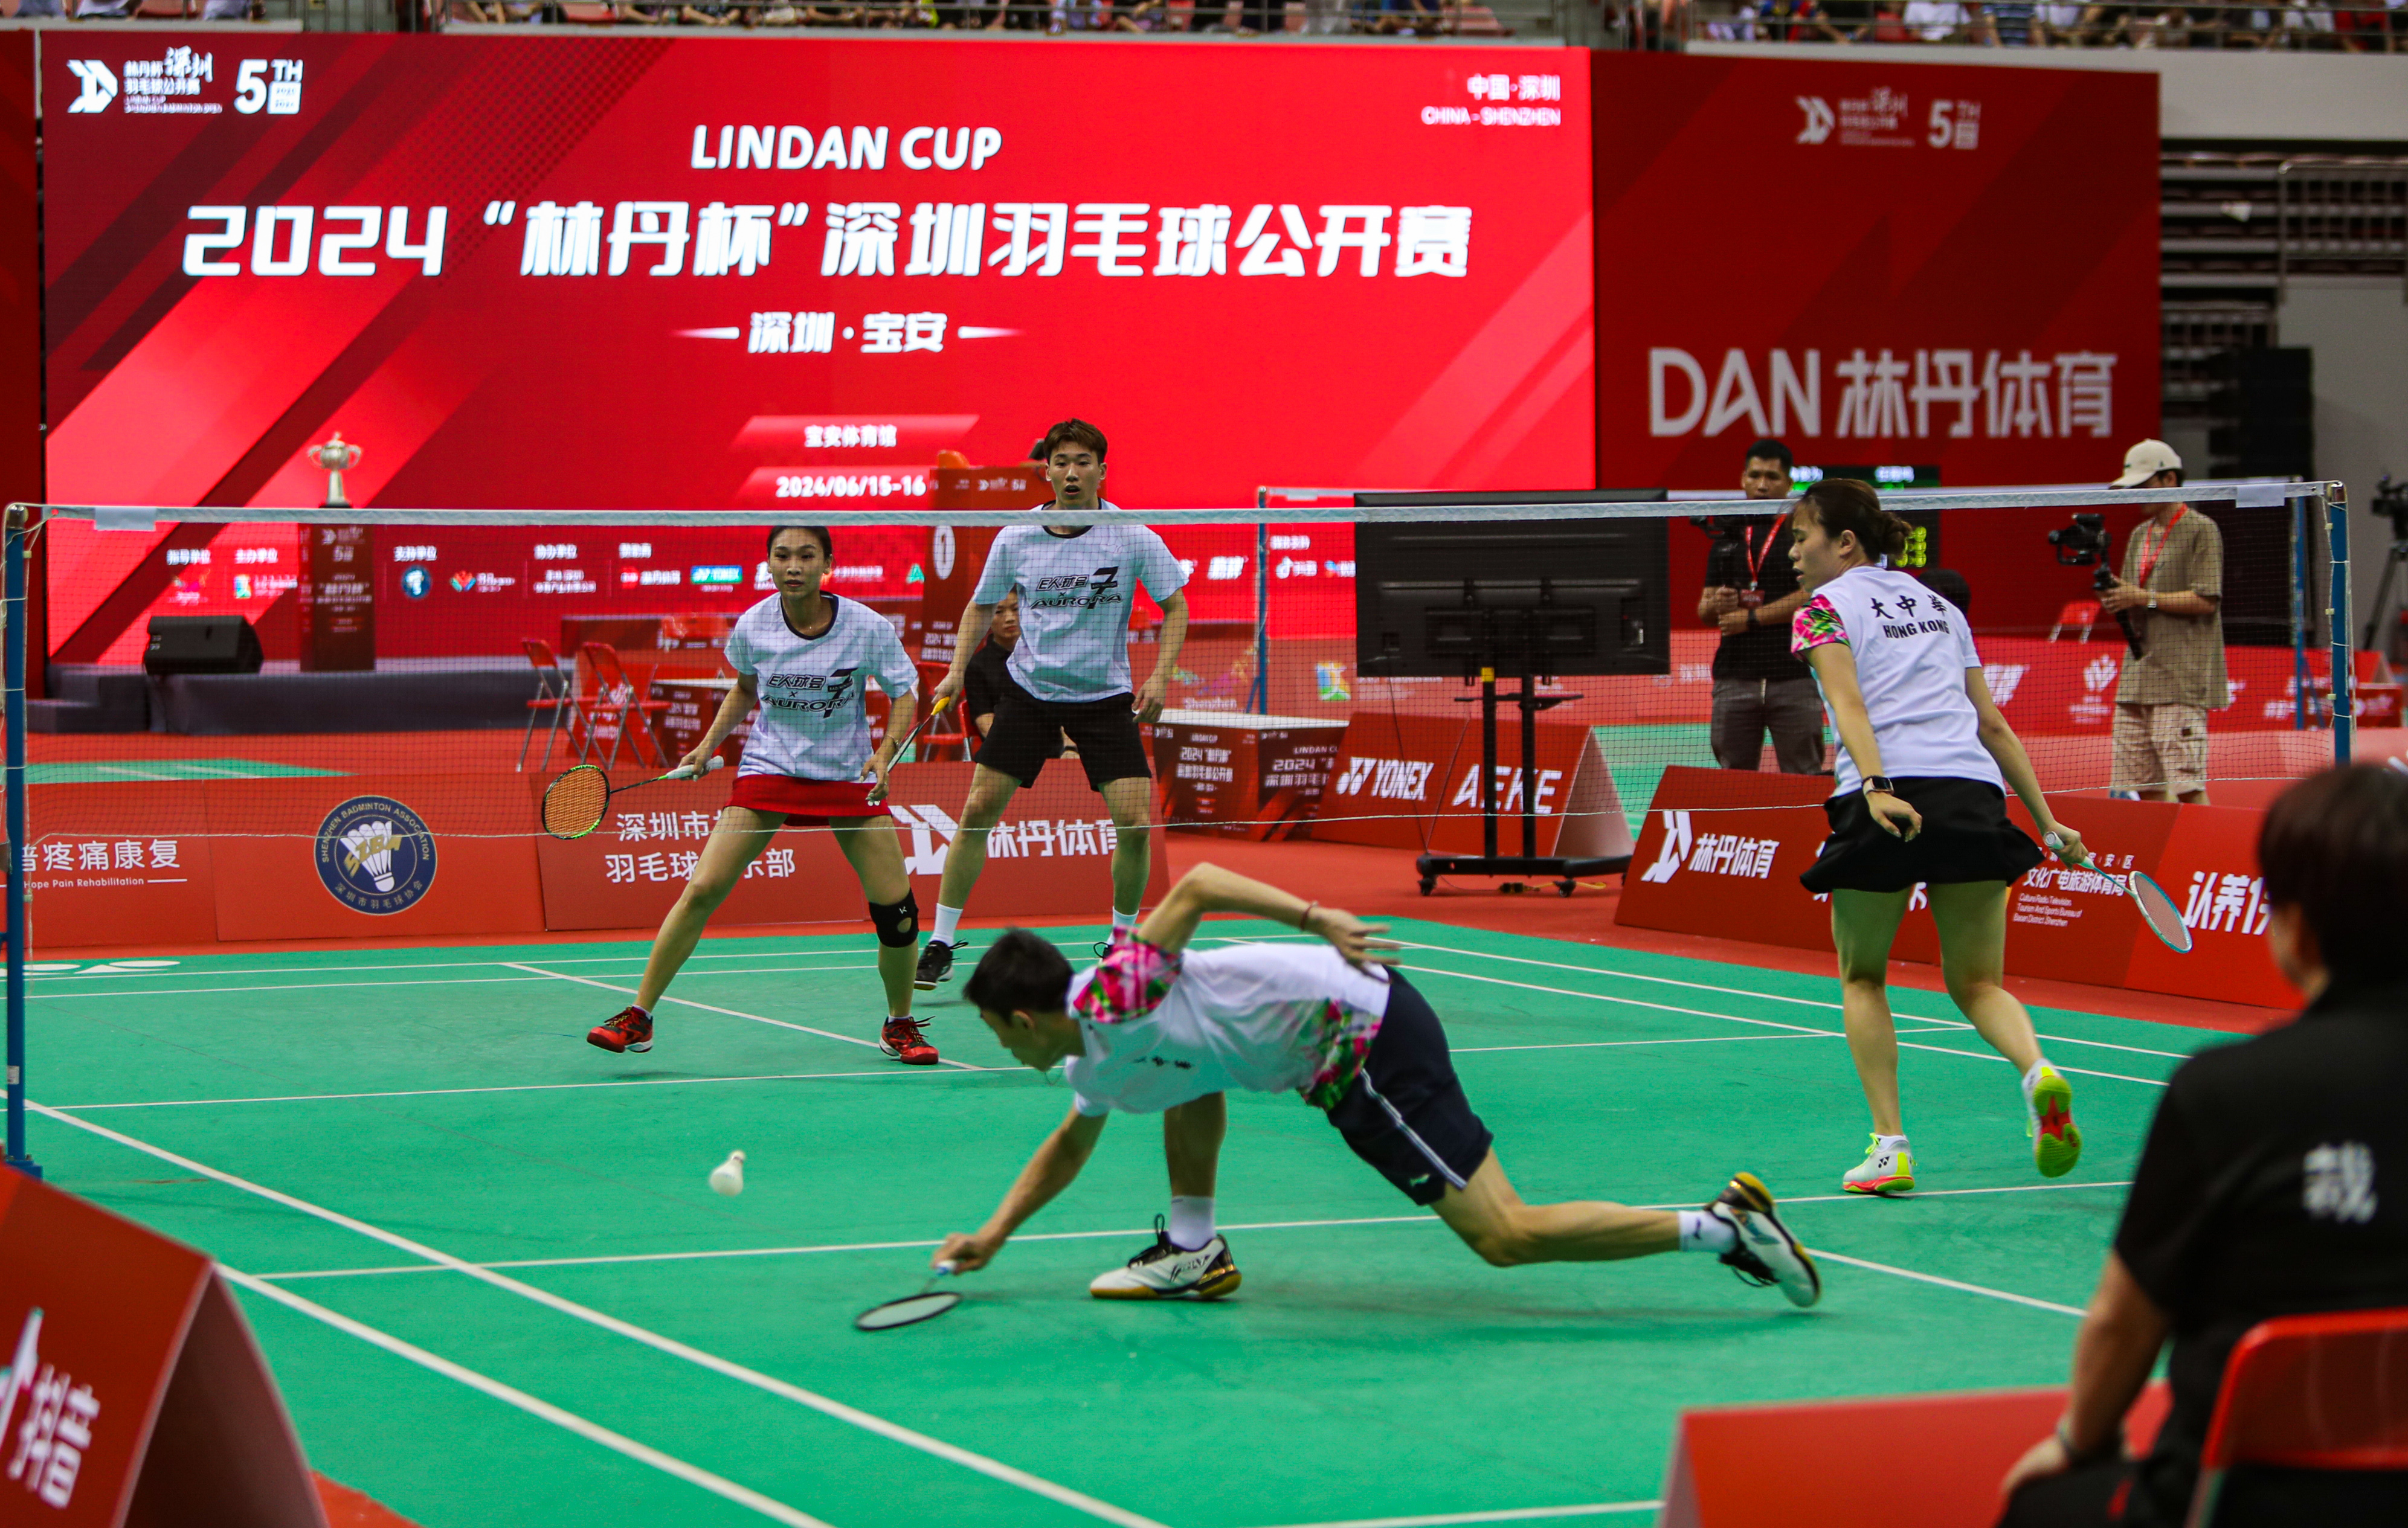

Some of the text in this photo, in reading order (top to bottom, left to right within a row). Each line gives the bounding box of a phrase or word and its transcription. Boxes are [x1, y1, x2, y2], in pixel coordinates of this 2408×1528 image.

[1467, 73, 1560, 101] 中国·深圳
[691, 124, 1002, 171] LINDAN CUP
[182, 205, 448, 277] 2024
[748, 312, 948, 353] 深圳·宝安
[1649, 346, 2119, 438] DAN 林丹体育
[804, 424, 898, 448] 宝安体育馆
[776, 475, 927, 498] 2024/06/15-16
[1029, 593, 1123, 610] AURORA
[1870, 594, 1948, 620] 大中華
[1882, 619, 1950, 639] HONG KONG
[761, 691, 854, 713] AURORA
[1293, 746, 1328, 755] LINDAN
[1273, 758, 1316, 772] 2024
[1370, 759, 1435, 801] YONEX
[321, 803, 430, 863] SHENZHEN BADMINTON ASSOCIATION
[616, 809, 722, 842] 深圳市
[1688, 832, 1780, 879] 林丹体育
[53, 878, 74, 888] Pain
[77, 876, 144, 887] Rehabilitation
